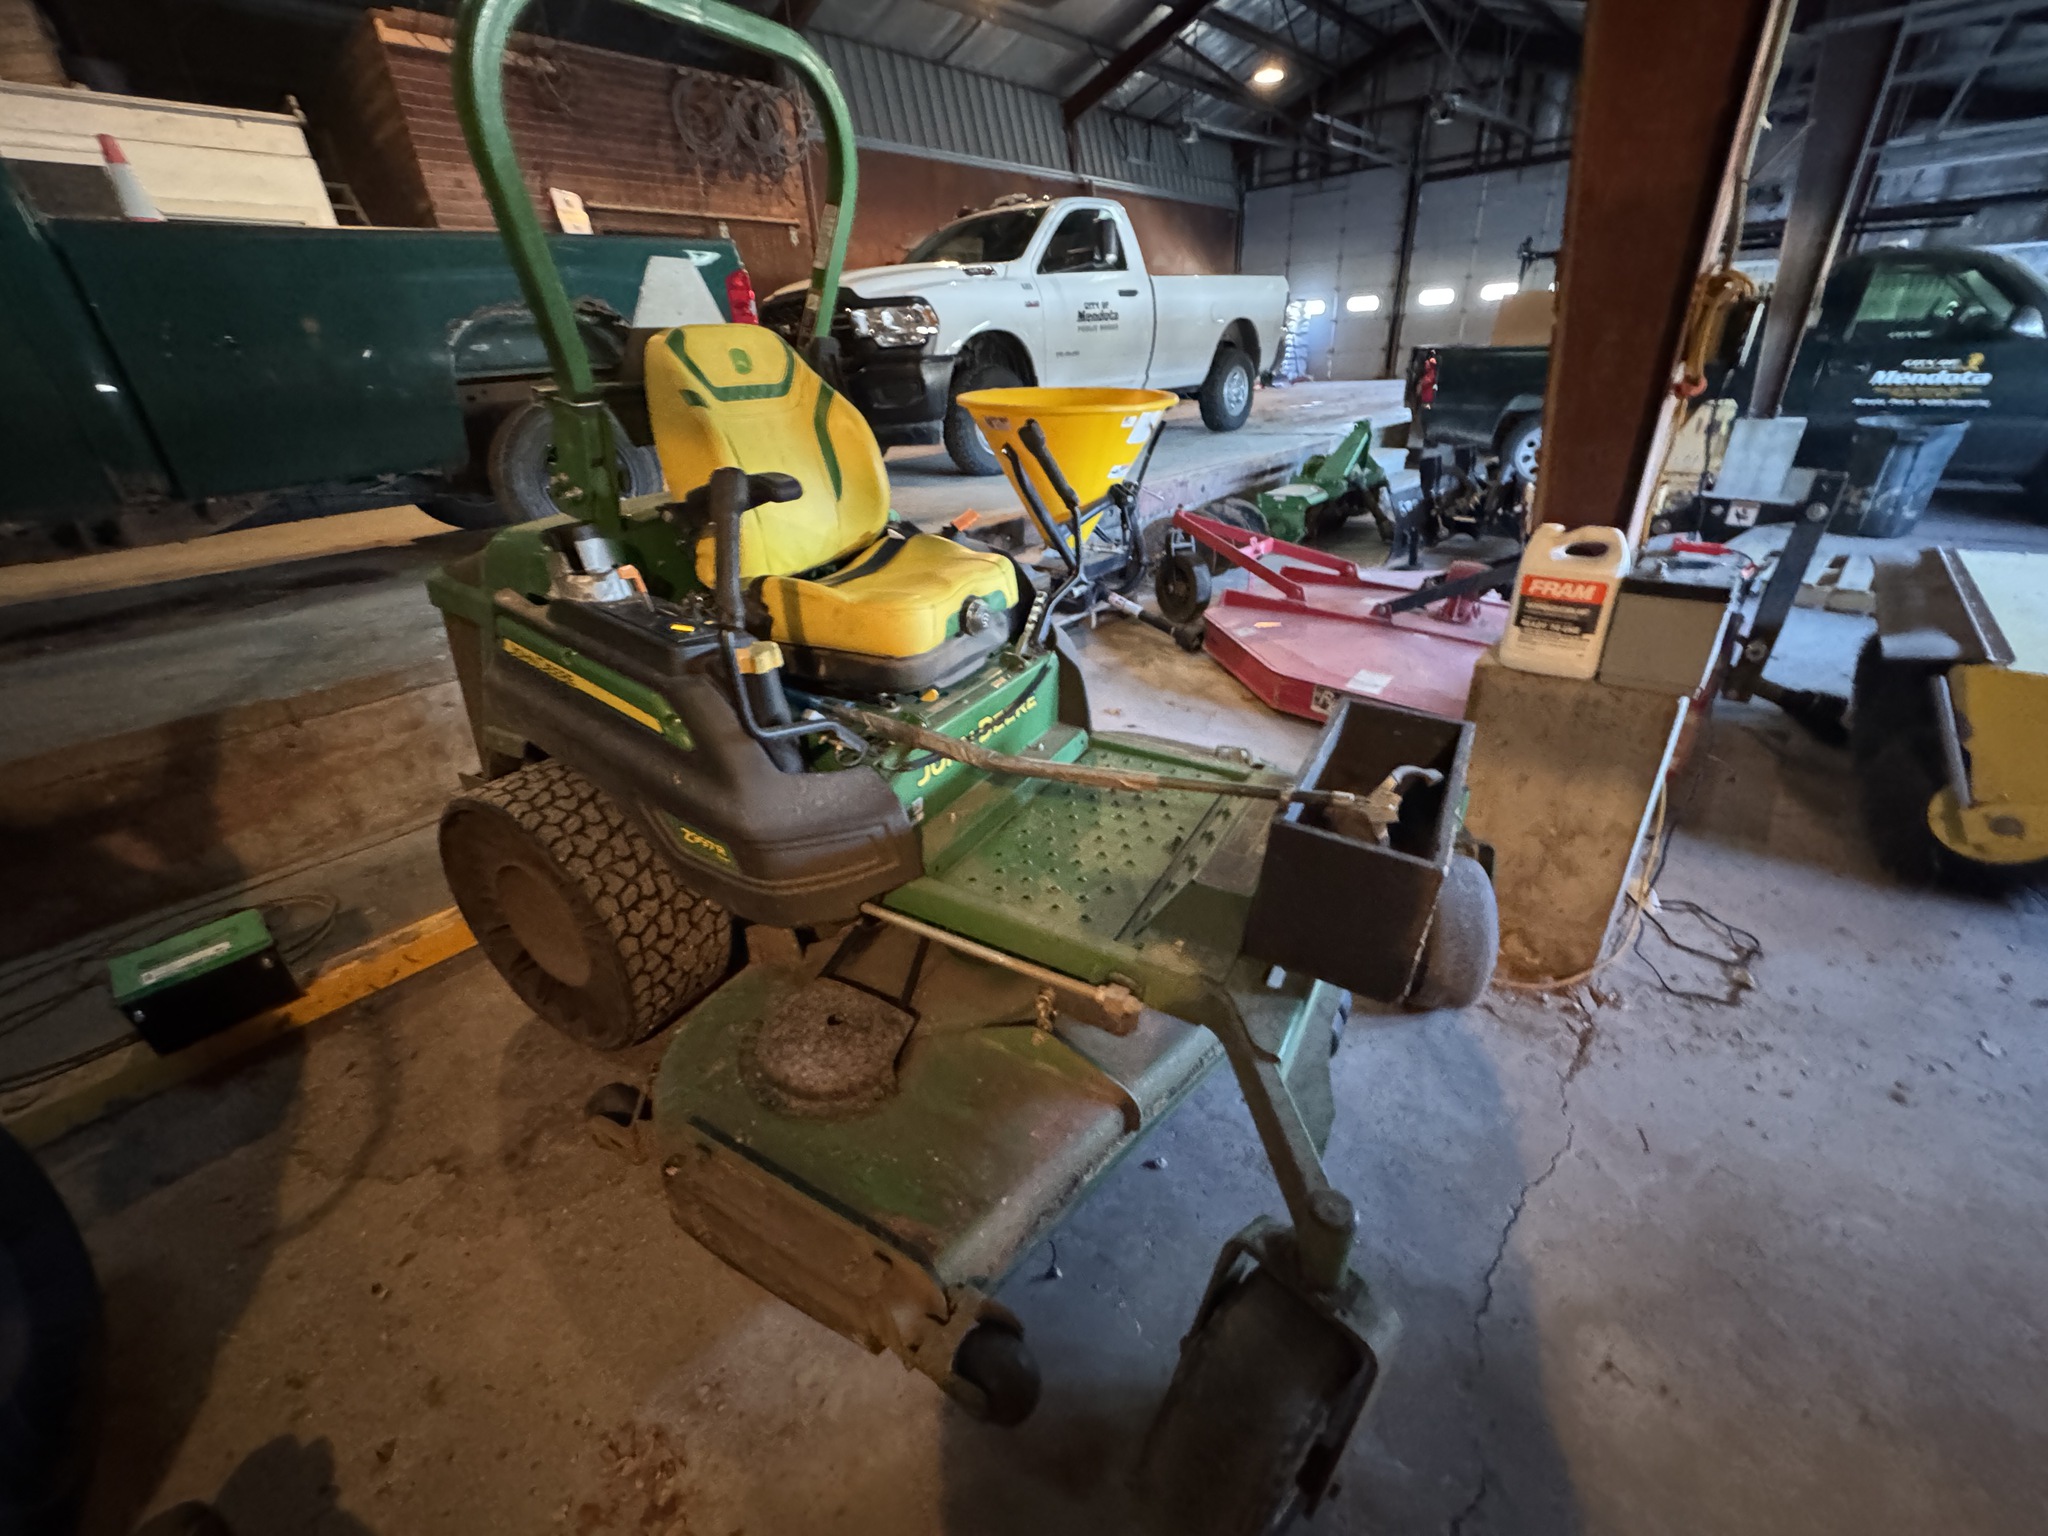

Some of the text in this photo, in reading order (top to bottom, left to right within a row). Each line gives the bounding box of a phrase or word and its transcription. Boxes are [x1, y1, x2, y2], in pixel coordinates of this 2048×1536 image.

[1077, 310, 1119, 322] Mendota
[1868, 370, 1994, 386] Mendota
[1528, 578, 1597, 601] FRAM
